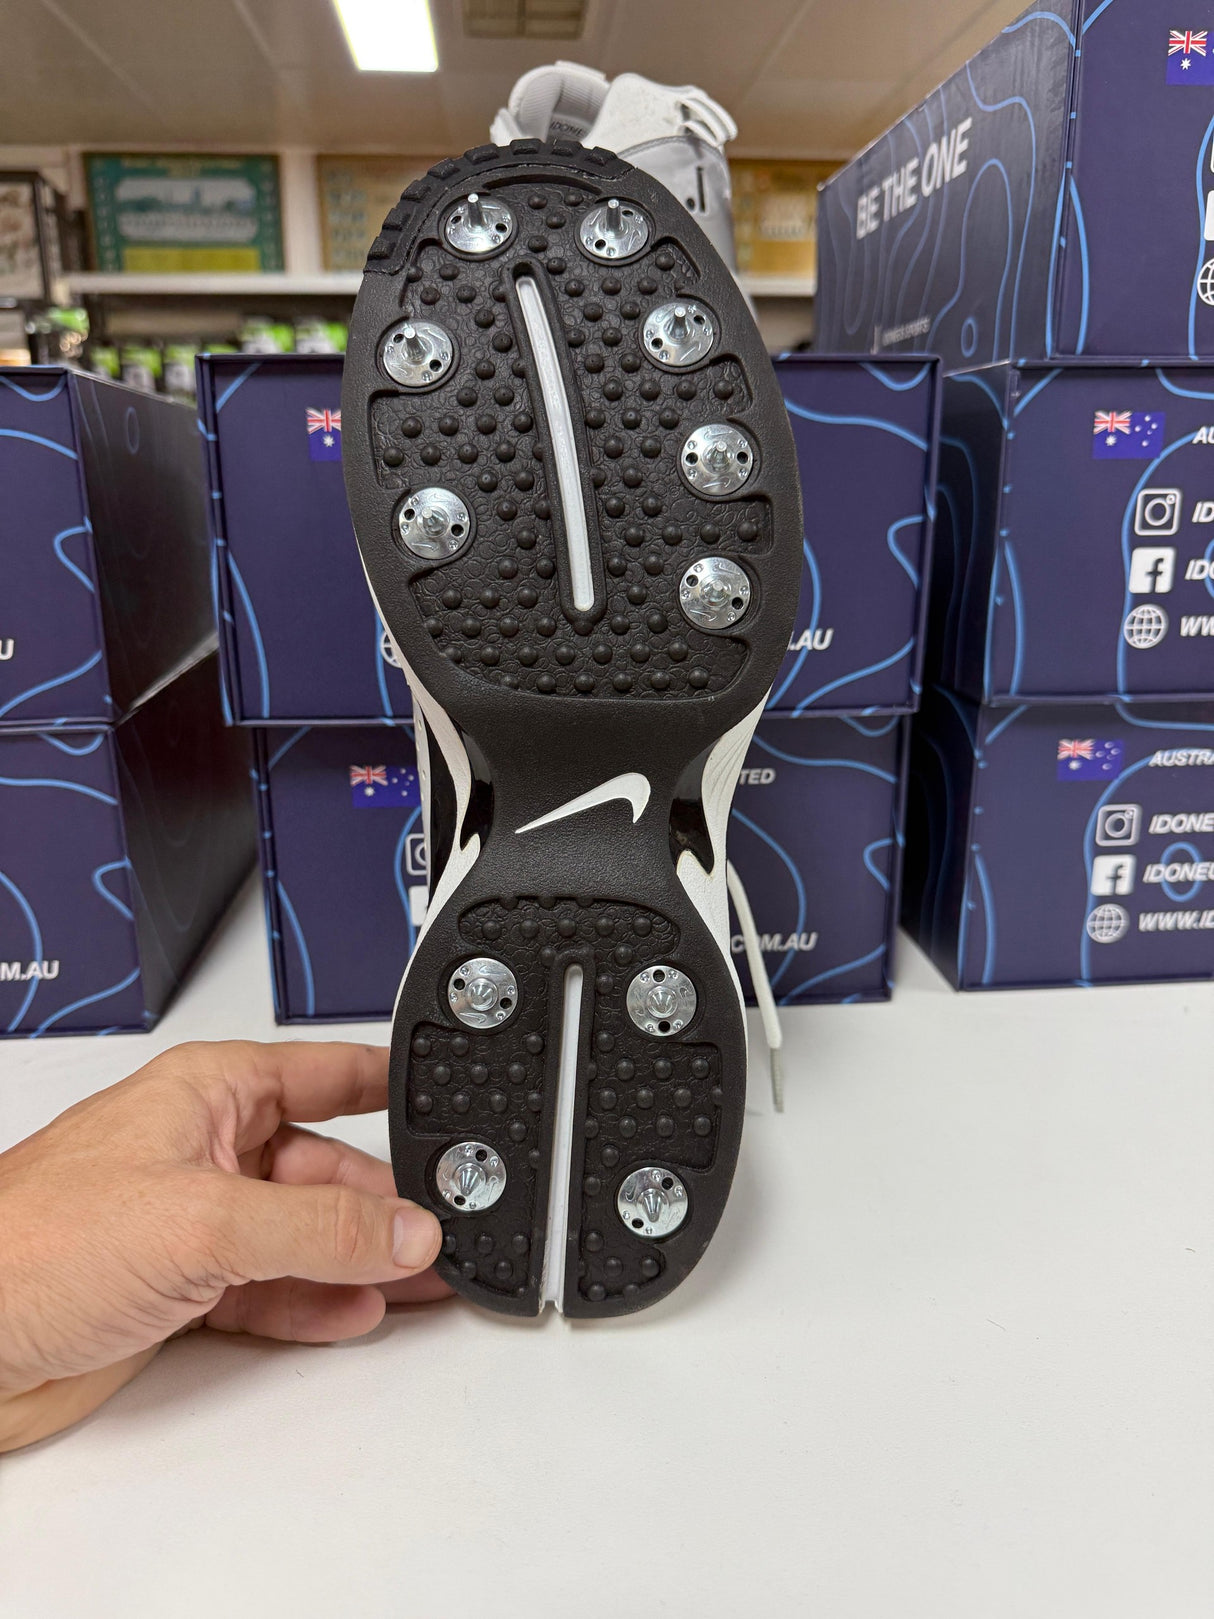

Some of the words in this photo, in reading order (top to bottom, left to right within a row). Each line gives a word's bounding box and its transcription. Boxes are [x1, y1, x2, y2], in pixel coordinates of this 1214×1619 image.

[856, 185, 881, 239] BE
[882, 157, 920, 222] THE
[921, 116, 973, 198] ONE
[731, 931, 818, 953] CM.AU
